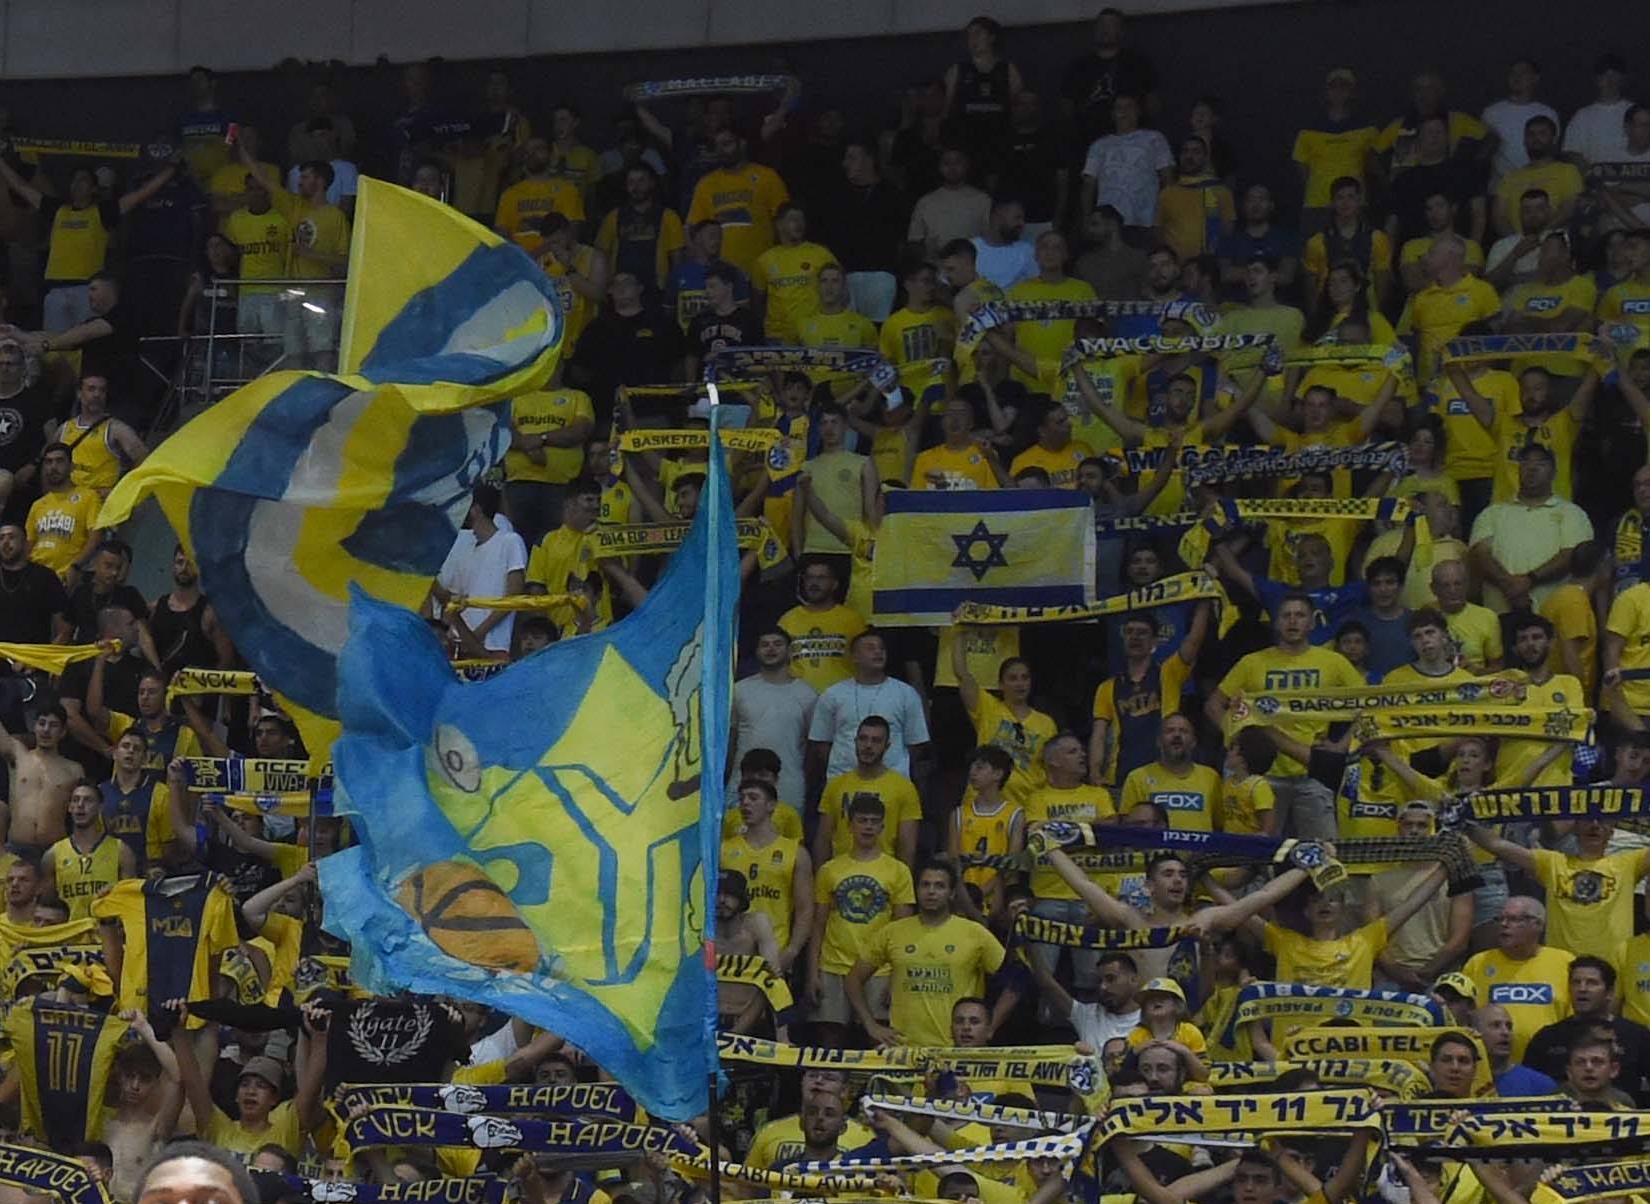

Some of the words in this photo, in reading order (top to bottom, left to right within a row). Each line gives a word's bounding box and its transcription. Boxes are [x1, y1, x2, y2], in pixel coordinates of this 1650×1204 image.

[1290, 694, 1410, 714] BARCELONA
[1482, 712, 1532, 727] מכבי
[1154, 792, 1202, 809] FOX
[1353, 803, 1397, 817] FOX
[79, 858, 93, 875] 12
[1492, 985, 1548, 1002] FOX
[39, 1007, 96, 1028] GATE
[366, 1014, 418, 1036] gate
[380, 1034, 399, 1050] 11
[46, 1031, 84, 1093] 11
[1005, 1061, 1032, 1080] TEL
[1033, 1063, 1067, 1081] AVIV
[509, 1085, 622, 1114] HAPOEL
[1271, 1096, 1299, 1122] 11
[1325, 1096, 1372, 1122] ער
[1215, 1098, 1258, 1123] יד
[353, 1112, 437, 1141] FVCK
[546, 1122, 679, 1154] HAPOEL
[1549, 1115, 1590, 1138] יד
[1605, 1115, 1641, 1139] 11
